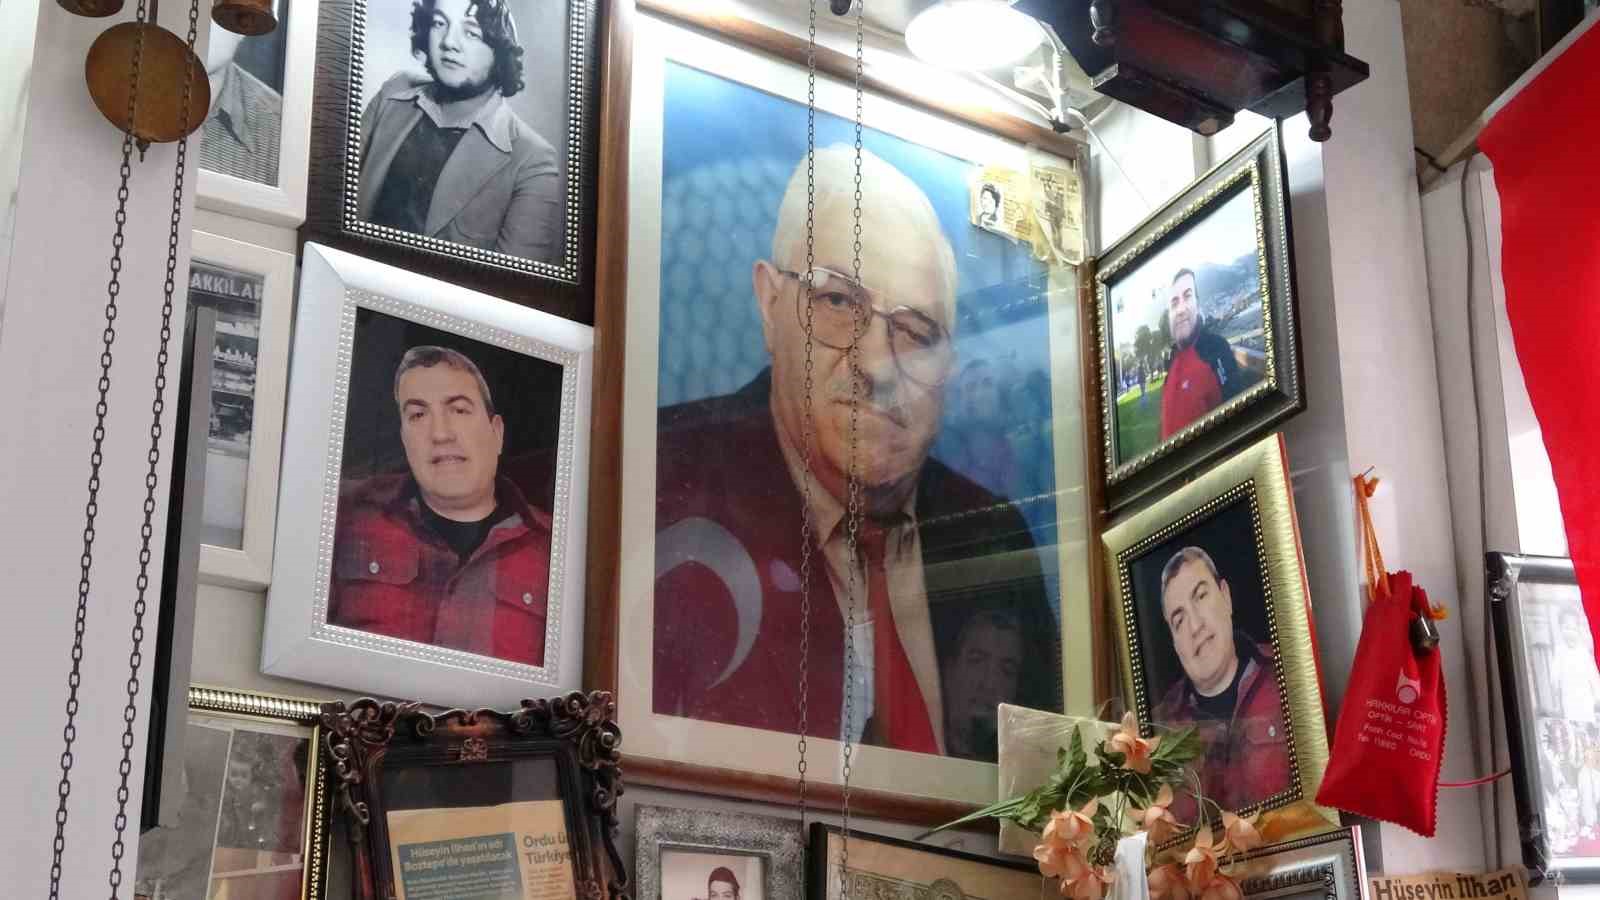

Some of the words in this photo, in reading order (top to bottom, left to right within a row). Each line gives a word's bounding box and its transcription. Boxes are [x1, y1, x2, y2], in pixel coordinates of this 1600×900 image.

[523, 834, 556, 848] Ordu
[1372, 878, 1454, 900] Hüseyin
[1456, 872, 1517, 899] İlhan
